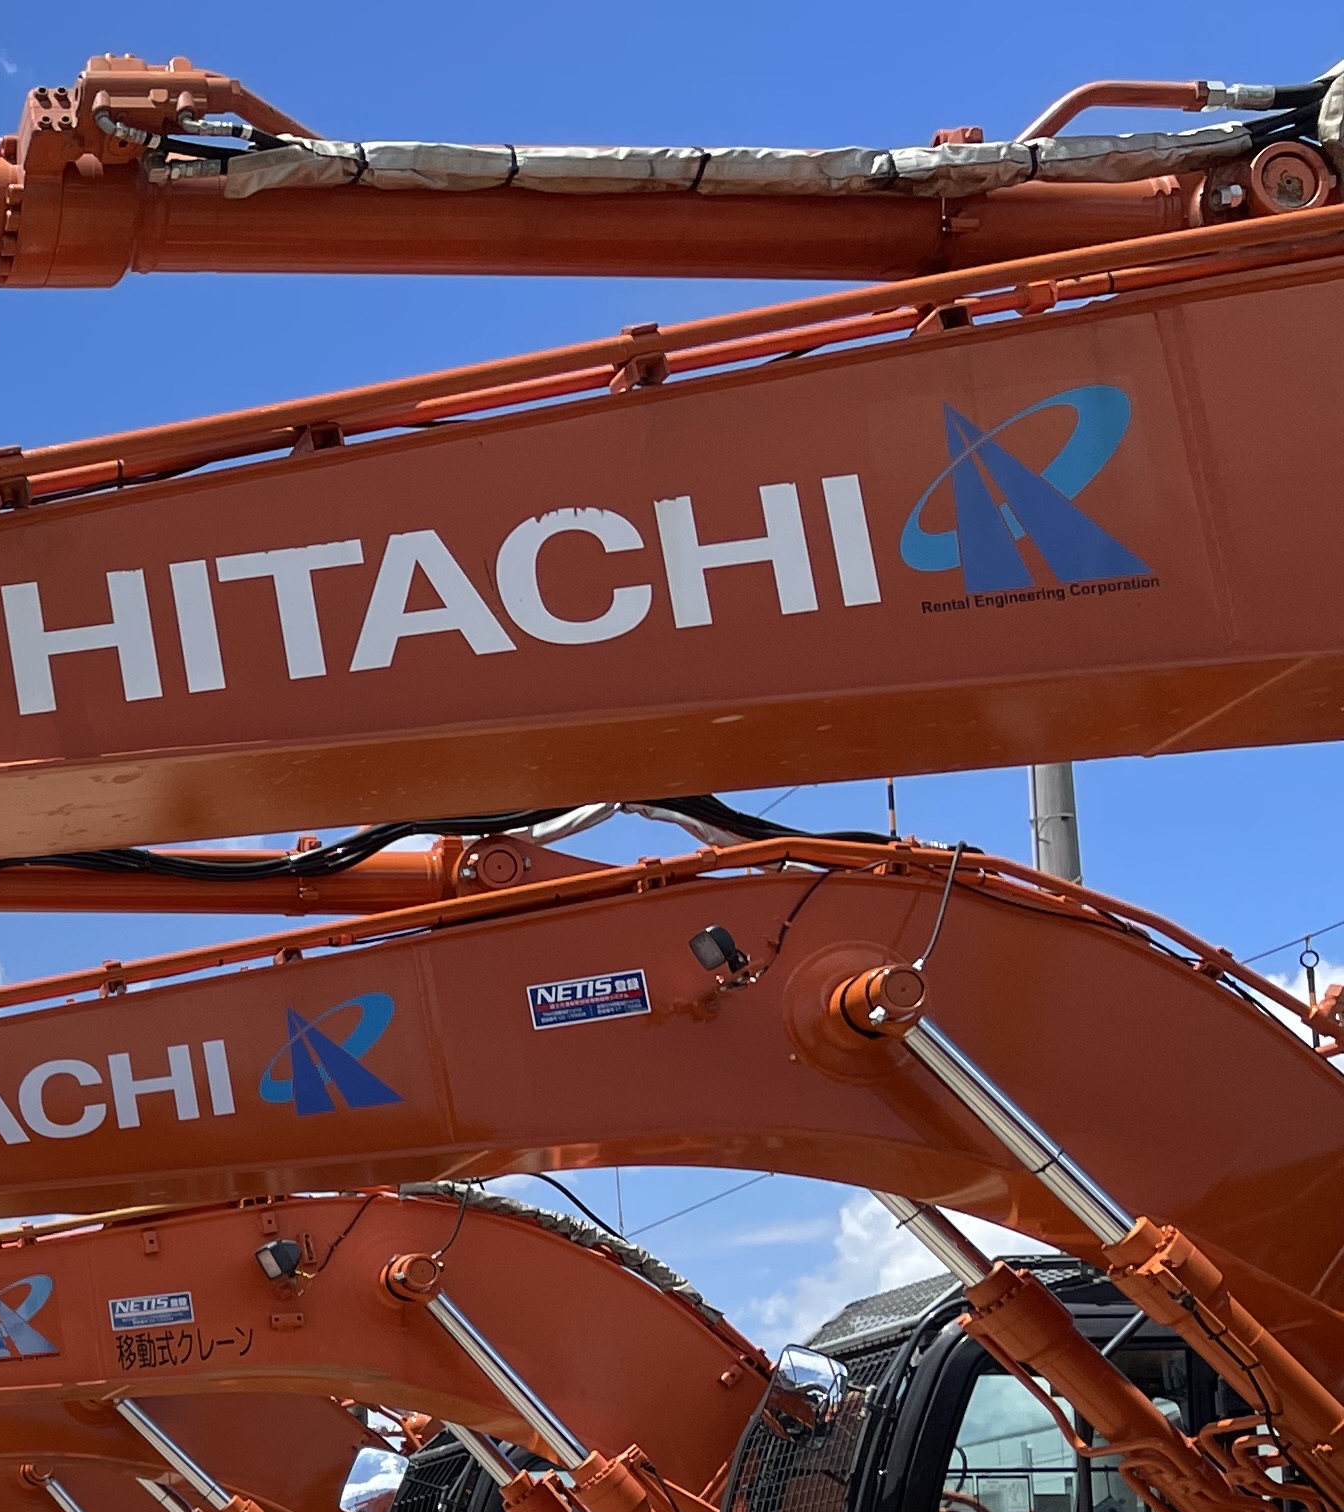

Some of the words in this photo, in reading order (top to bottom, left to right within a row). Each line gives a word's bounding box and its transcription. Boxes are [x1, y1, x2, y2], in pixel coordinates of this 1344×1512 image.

[0, 474, 882, 715] HITACHI
[921, 599, 970, 614] Rental
[975, 587, 1066, 609] Engineering
[1069, 576, 1160, 597] Corporation
[537, 978, 612, 1005] NETIS
[115, 1296, 169, 1314] NETIS
[115, 1326, 253, 1371] 移動式クレーン
